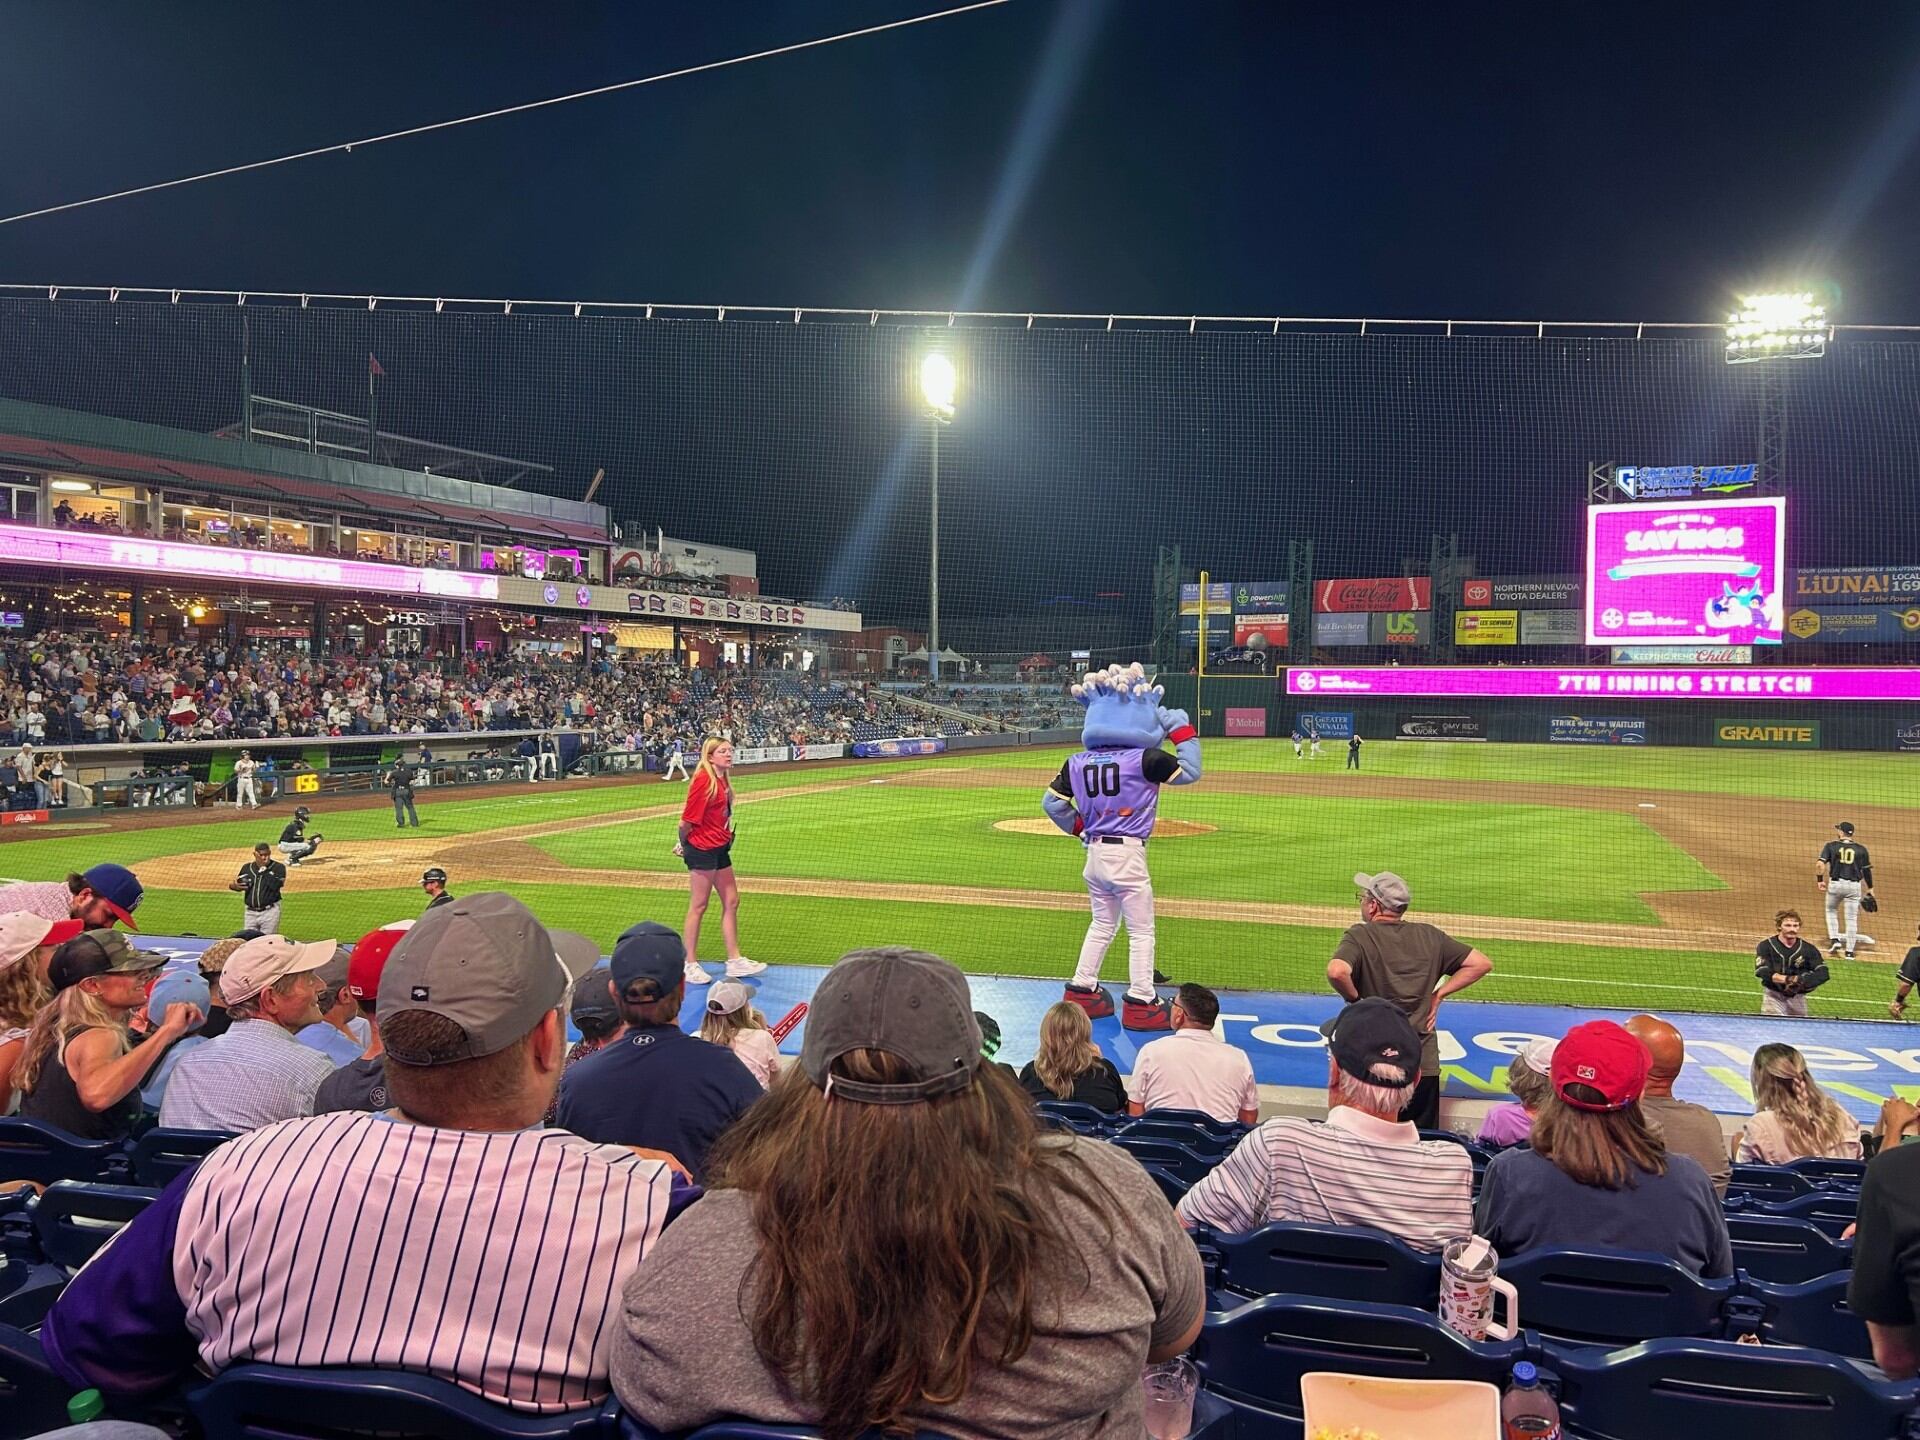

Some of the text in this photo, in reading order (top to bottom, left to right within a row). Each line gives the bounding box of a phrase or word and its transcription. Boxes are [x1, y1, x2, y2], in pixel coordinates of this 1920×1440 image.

[1625, 526, 1745, 552] SAVINGS
[1892, 573, 1920, 582] LOCAL
[1494, 583, 1580, 593] NORTHERN NEVADA
[1797, 575, 1889, 594] LiUNA!
[1250, 593, 1286, 603] powershift
[1340, 582, 1400, 604] Coca-Cola
[1494, 592, 1568, 601] TOYOTA DEALERS
[1386, 633, 1416, 644] FOODS
[1634, 648, 1737, 663] KEEPING RENO Chill
[1559, 675, 1812, 693] 7TH INNING STRETCH
[1315, 715, 1348, 723] GREATER
[1551, 719, 1576, 728] STRIKE
[1608, 720, 1645, 730] WAITLIST!
[1316, 722, 1349, 731] NEVADA
[1415, 728, 1438, 736] WORK
[1720, 726, 1812, 742] GRANITE
[1083, 762, 1120, 799] 00
[1838, 846, 1856, 865] 10
